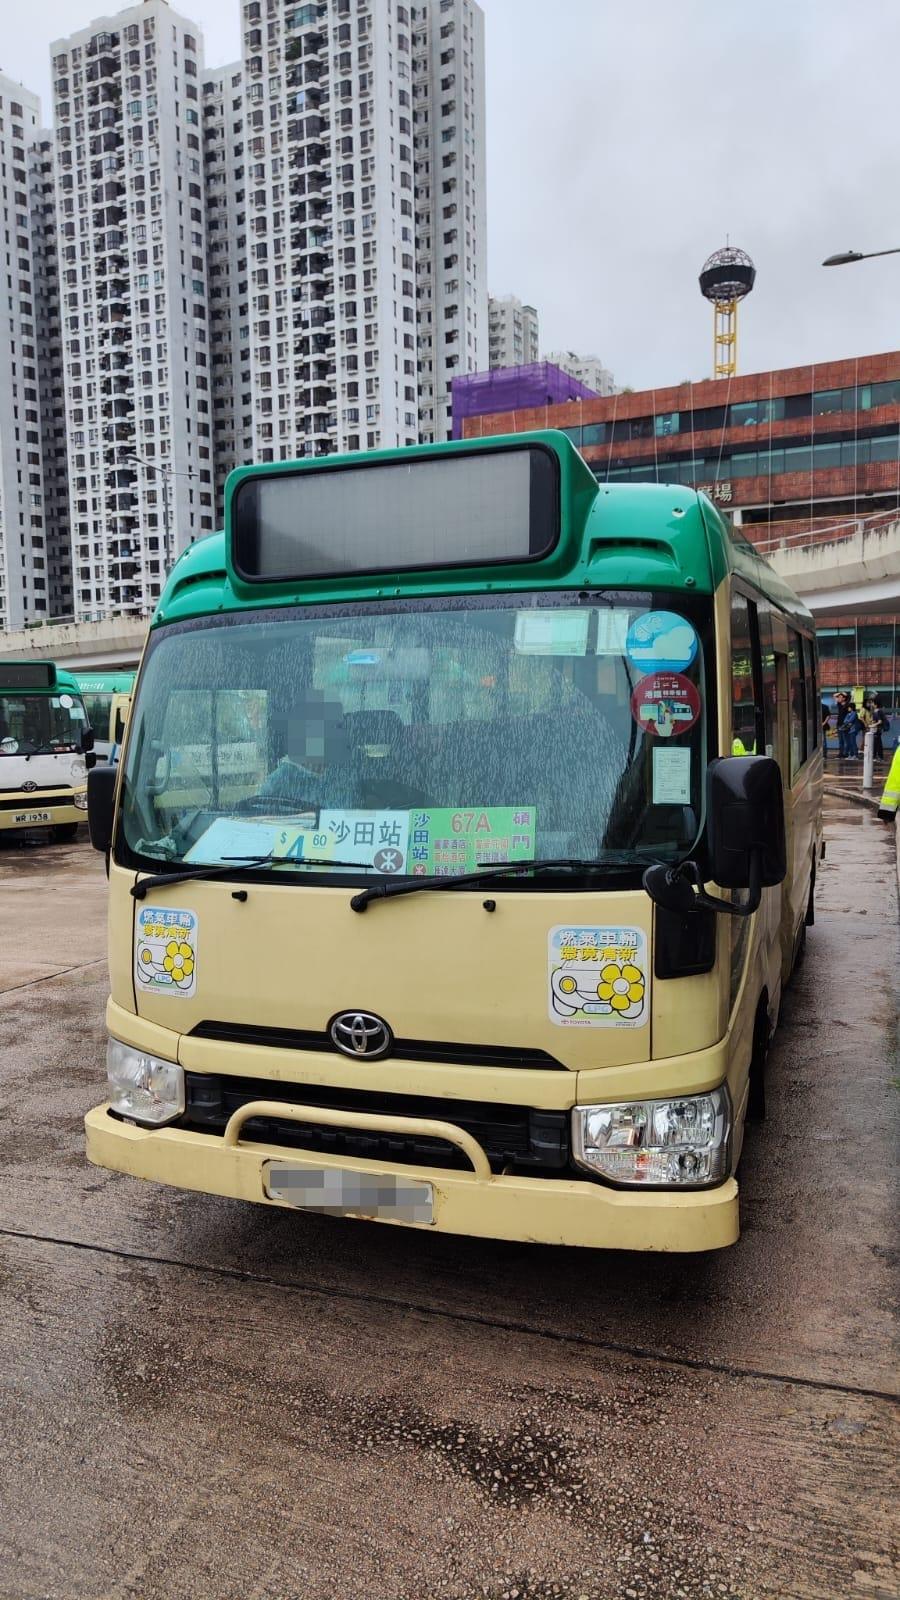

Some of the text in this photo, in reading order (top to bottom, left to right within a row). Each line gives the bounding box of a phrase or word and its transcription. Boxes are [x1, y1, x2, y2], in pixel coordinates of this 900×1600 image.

[29, 813, 48, 822] 1938
[451, 813, 491, 833] 67A
[328, 820, 402, 847] 沙田站
[412, 813, 430, 860] 沙田站
[286, 835, 305, 863] 4
[312, 834, 327, 847] 60
